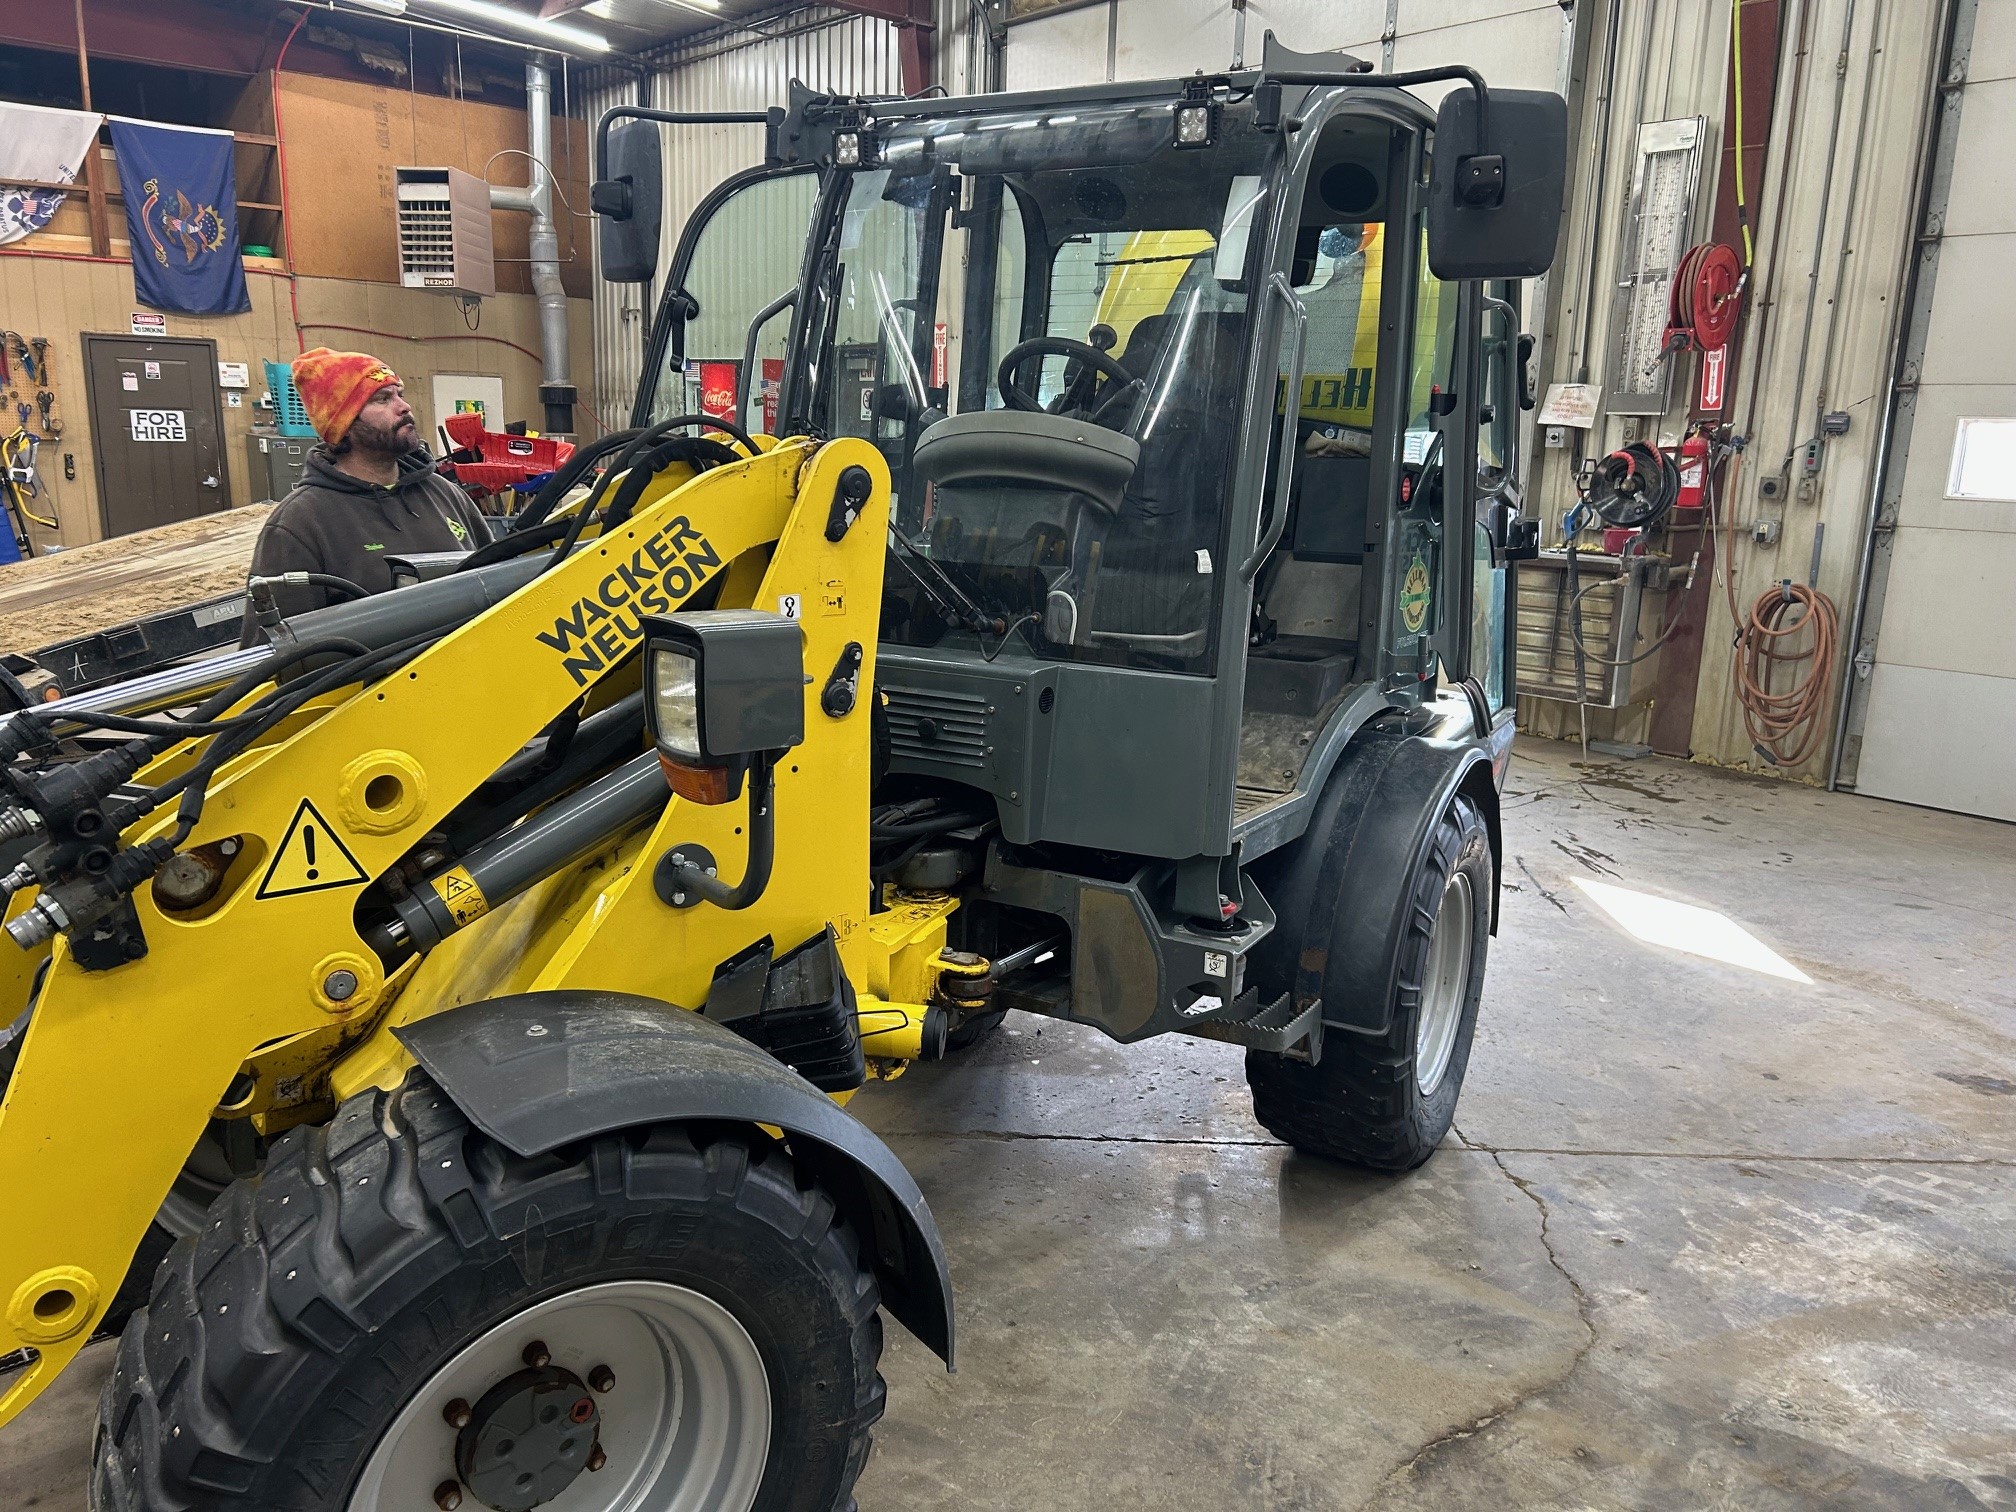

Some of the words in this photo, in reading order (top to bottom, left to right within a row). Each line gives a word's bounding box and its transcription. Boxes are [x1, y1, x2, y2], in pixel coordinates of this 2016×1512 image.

[936, 332, 946, 345] FIRE
[704, 390, 734, 407] Coca-Cola
[766, 400, 778, 408] rea
[136, 412, 180, 425] FOR
[766, 408, 777, 418] thi
[134, 426, 184, 439] HIRE
[535, 515, 703, 654] WACKER
[562, 538, 722, 688] NEUSON
